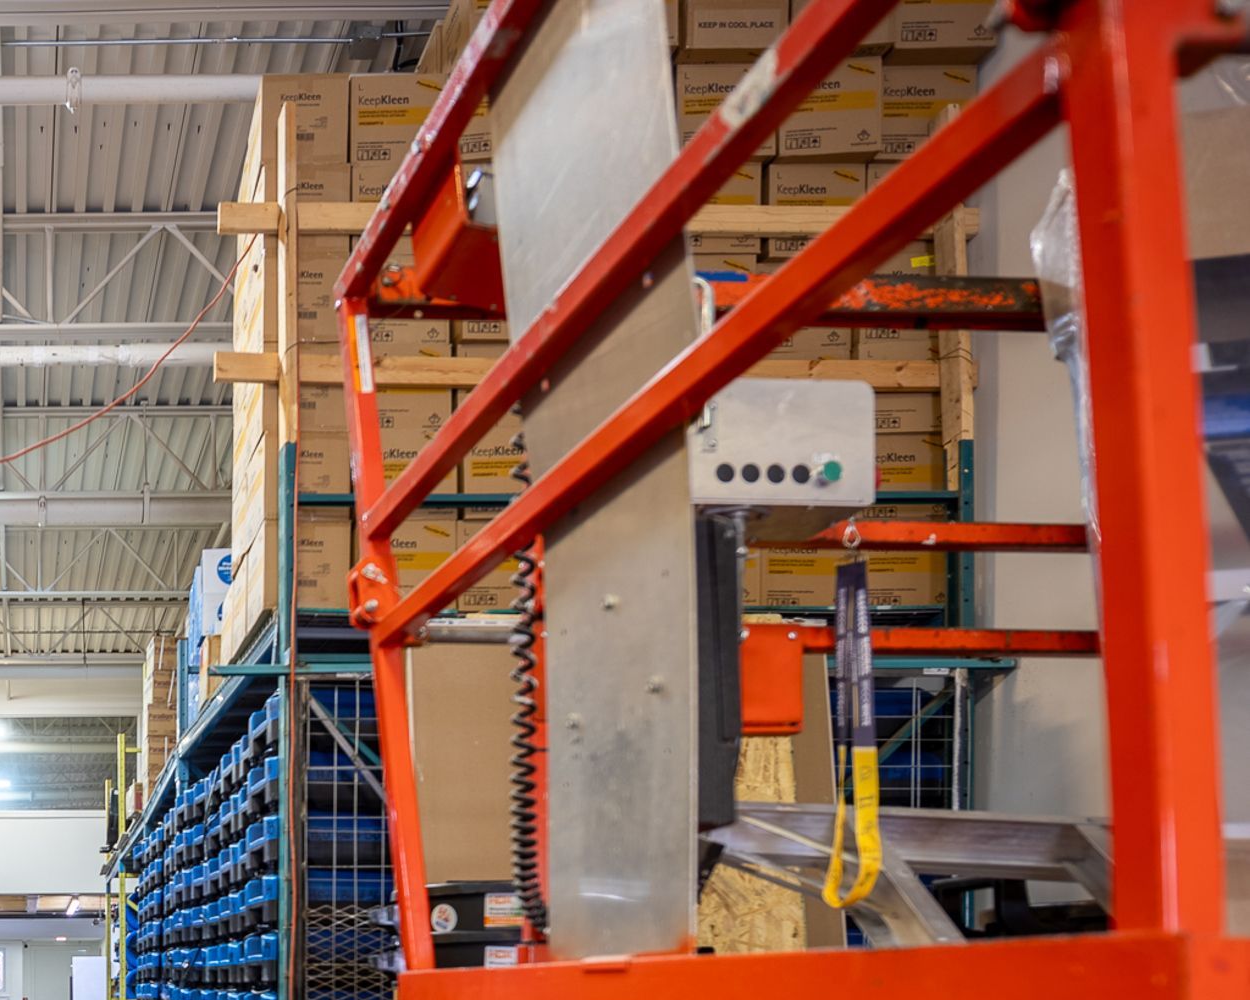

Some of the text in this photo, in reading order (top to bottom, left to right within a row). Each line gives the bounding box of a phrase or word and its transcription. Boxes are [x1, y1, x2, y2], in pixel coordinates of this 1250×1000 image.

[883, 86, 936, 101] KeepKleen
[358, 95, 410, 107] KeepKleen
[777, 183, 827, 195] KeepKleen
